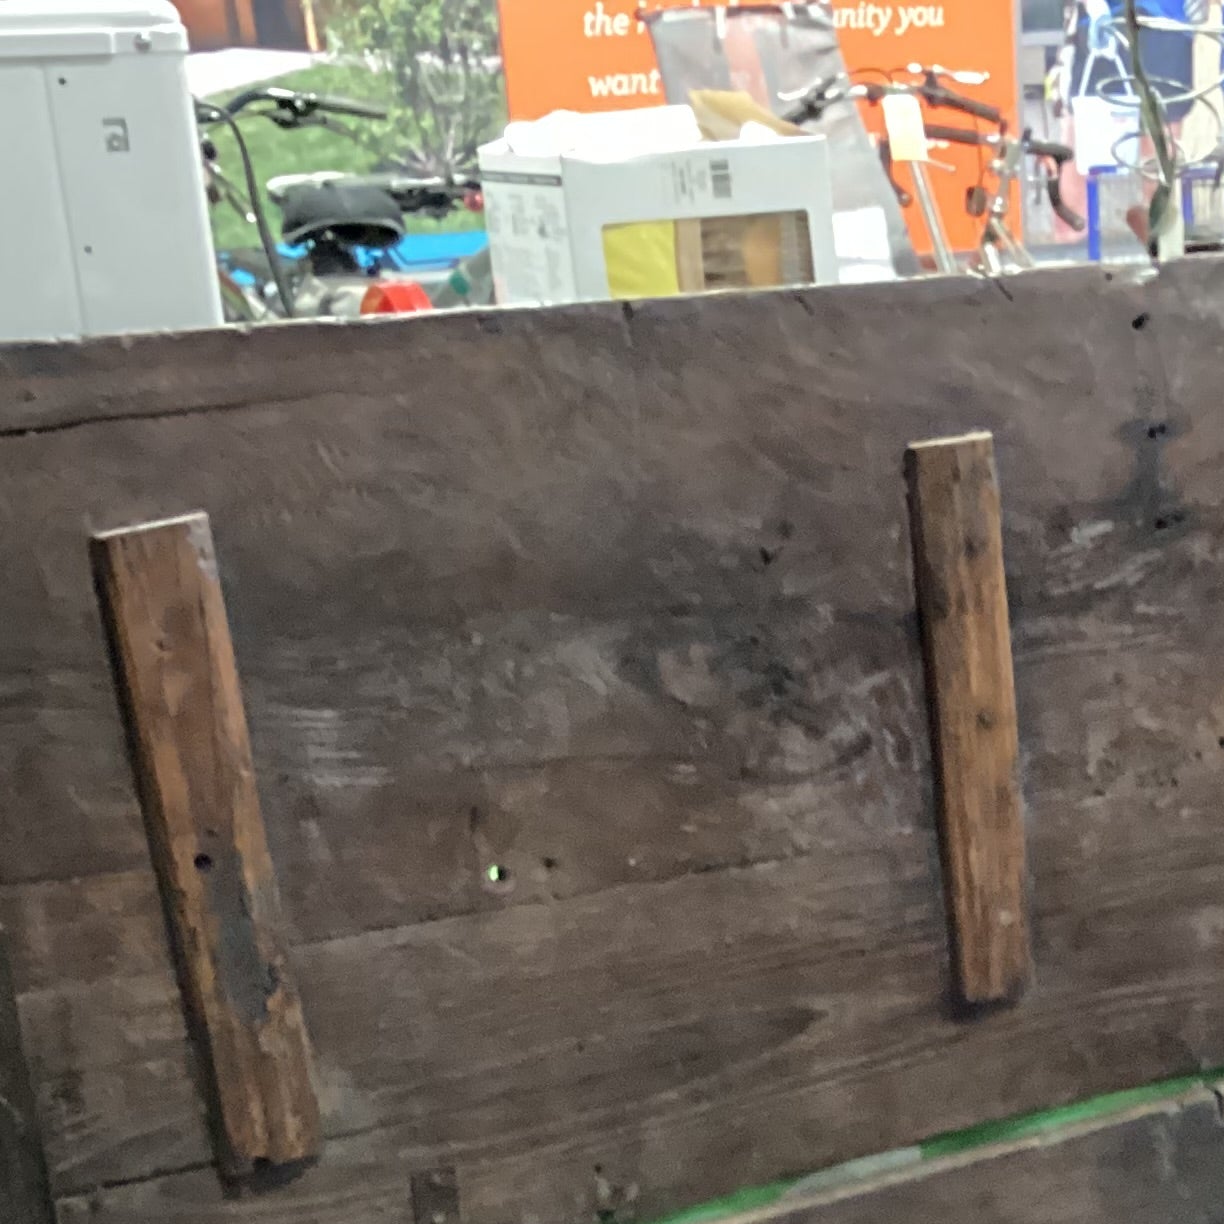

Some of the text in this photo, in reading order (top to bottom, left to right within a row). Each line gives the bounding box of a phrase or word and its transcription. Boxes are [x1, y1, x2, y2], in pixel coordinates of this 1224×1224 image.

[583, 2, 630, 37] the
[832, 1, 893, 37] unity
[894, 6, 945, 36] you
[588, 69, 661, 97] want
